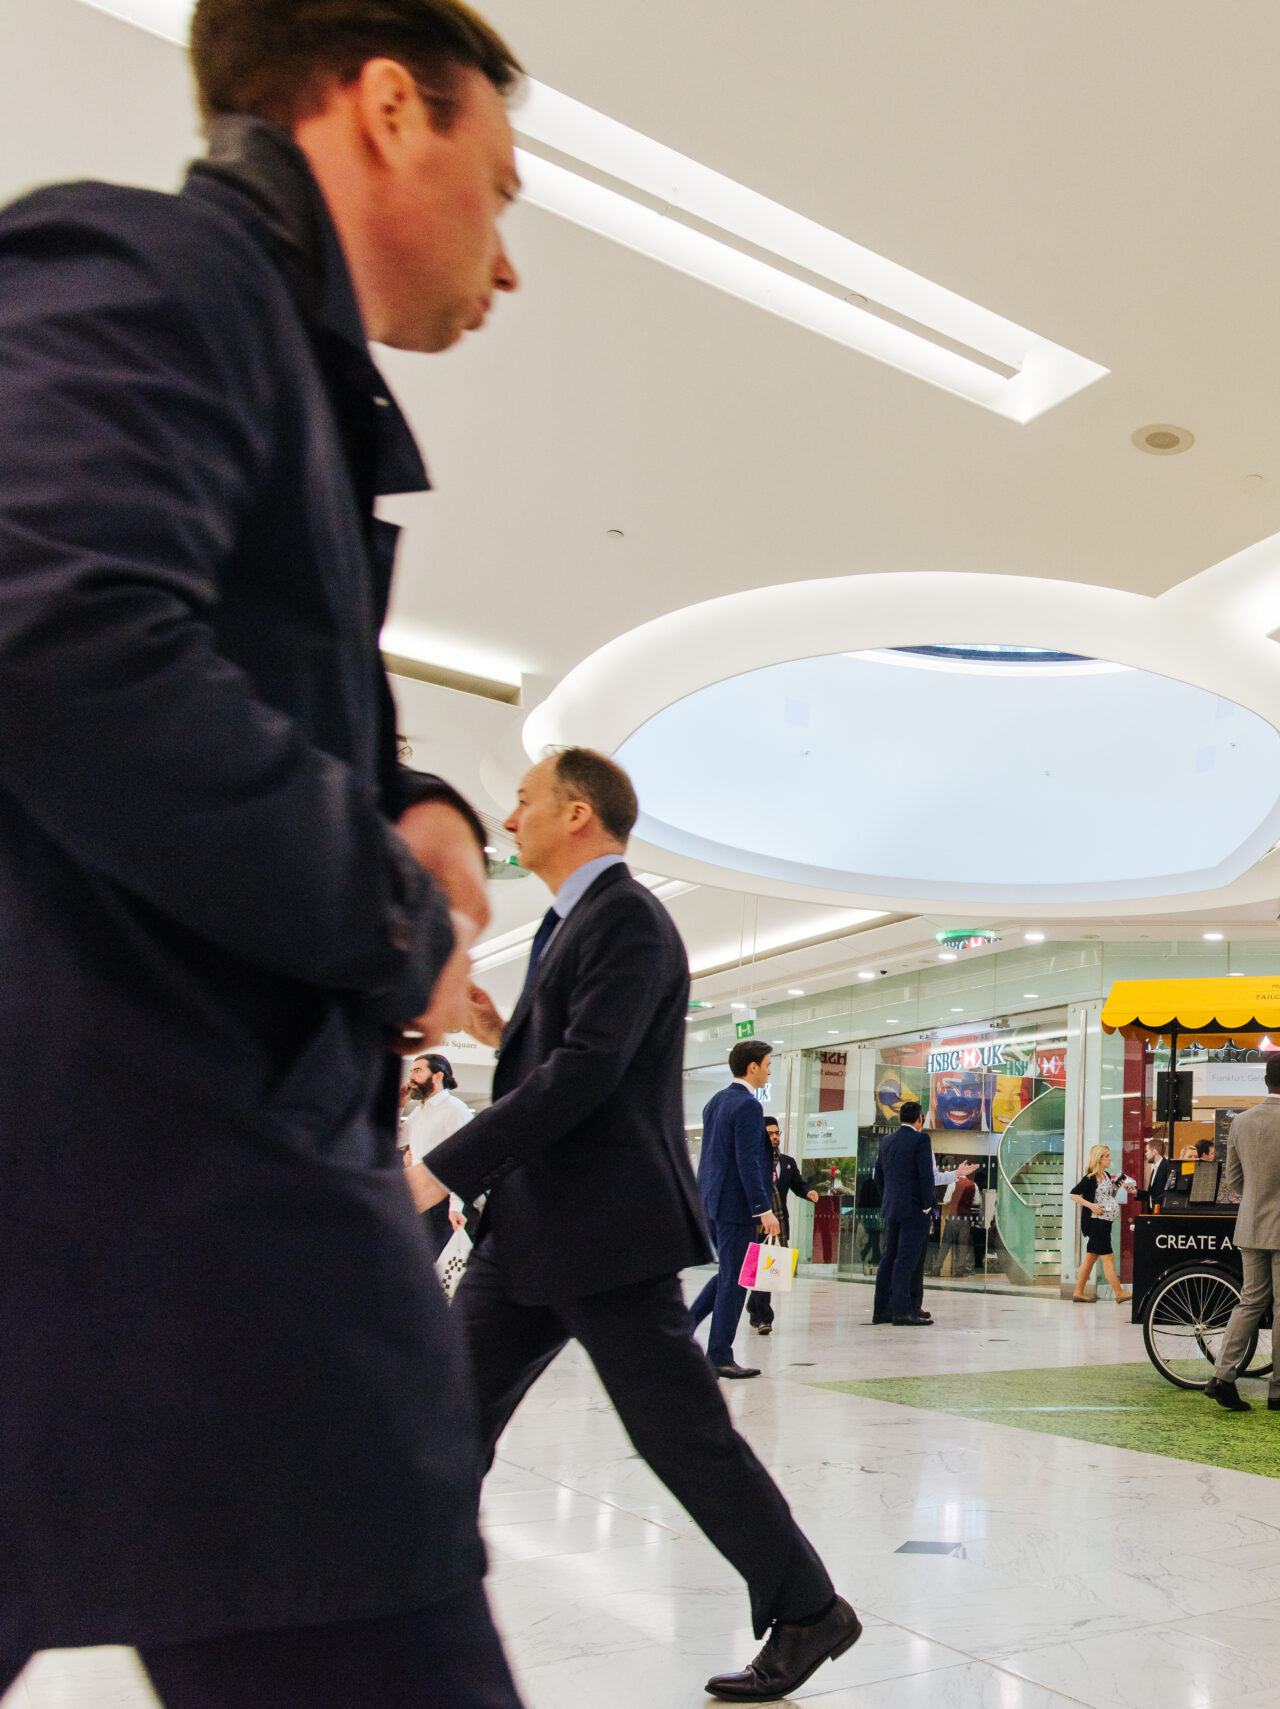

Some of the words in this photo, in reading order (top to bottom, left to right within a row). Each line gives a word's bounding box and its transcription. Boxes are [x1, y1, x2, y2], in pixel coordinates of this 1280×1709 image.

[451, 1040, 478, 1049] Square
[926, 1049, 962, 1075] HSBC
[979, 1044, 1007, 1067] UK
[1247, 1074, 1267, 1082] Gene
[1156, 1235, 1217, 1250] CREATE
[1221, 1236, 1233, 1250] A
